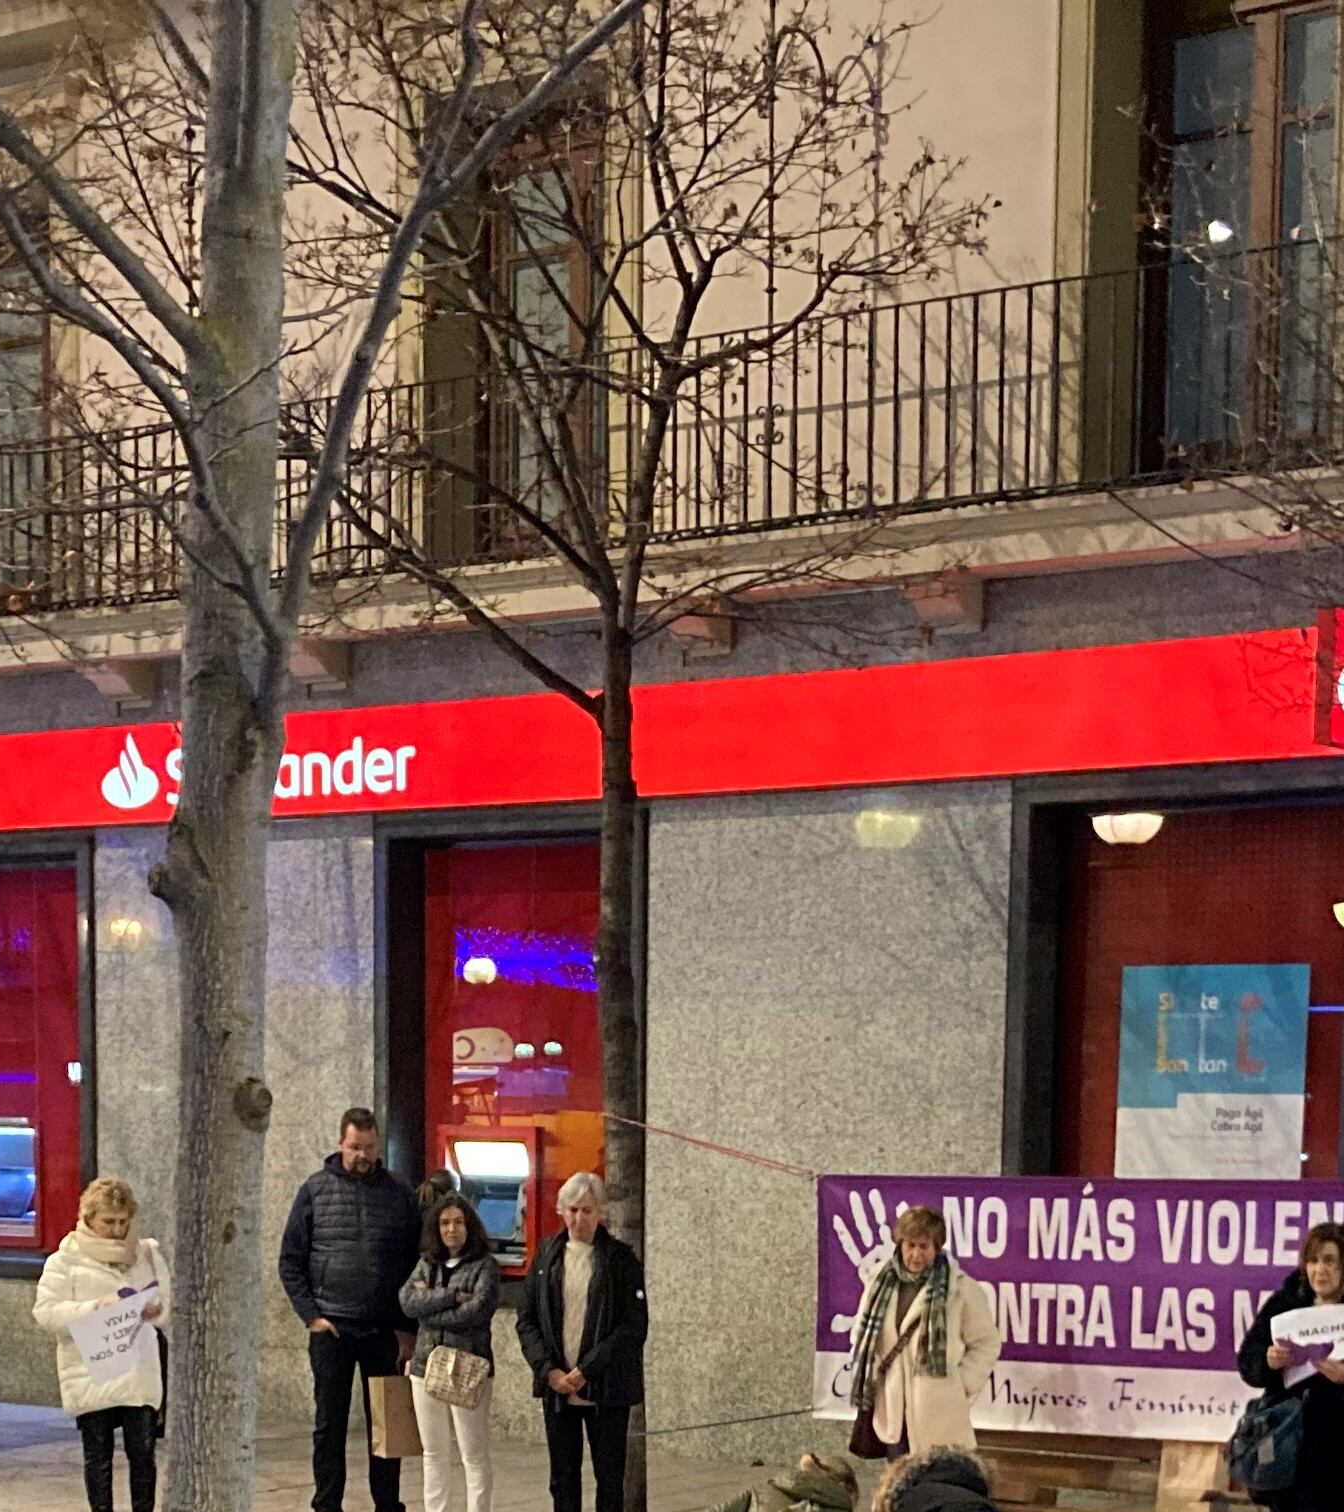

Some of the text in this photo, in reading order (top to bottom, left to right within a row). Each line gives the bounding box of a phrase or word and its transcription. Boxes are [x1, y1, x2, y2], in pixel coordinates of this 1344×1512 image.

[165, 735, 416, 807] Sander
[942, 1196, 1007, 1260] NO
[1027, 1181, 1136, 1263] MÁS
[103, 1308, 138, 1328] VIVAS
[1130, 1285, 1217, 1352] LAS
[89, 1349, 114, 1362] NOS
[1108, 1377, 1241, 1416] Feminist
